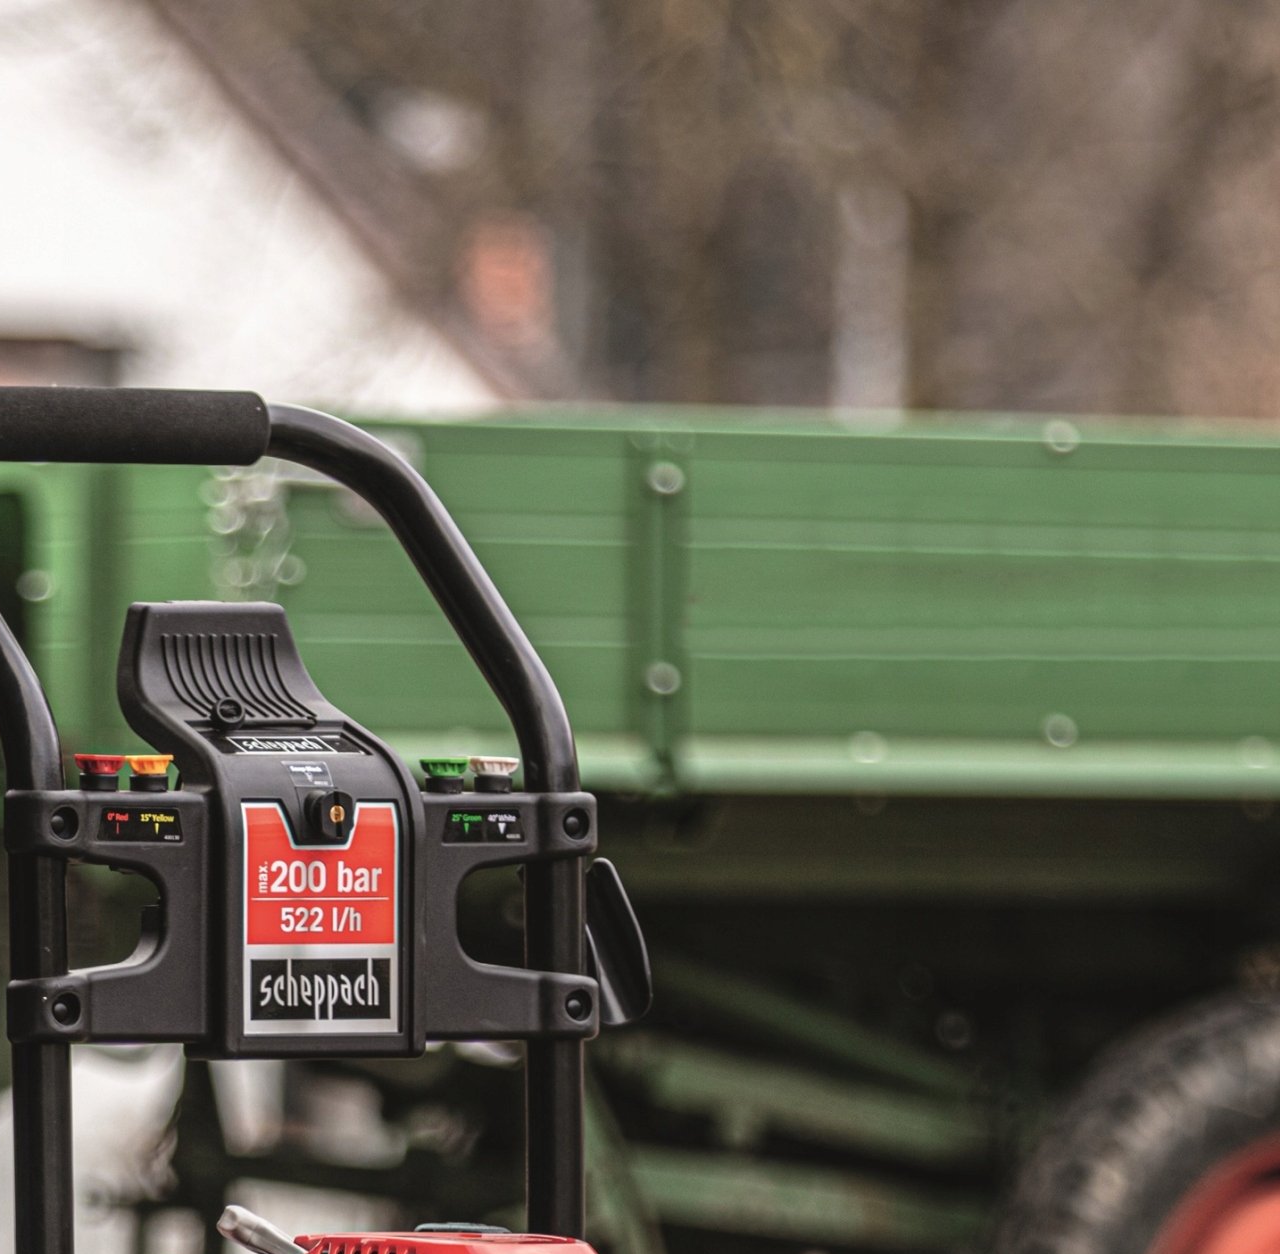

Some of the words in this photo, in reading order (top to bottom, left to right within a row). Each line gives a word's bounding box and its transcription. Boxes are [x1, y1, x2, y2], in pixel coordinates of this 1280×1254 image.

[242, 737, 323, 753] scheppach
[116, 813, 129, 821] Red
[152, 813, 175, 823] Yellow
[463, 814, 483, 822] Green
[498, 814, 517, 822] White
[258, 861, 269, 894] max.
[270, 860, 327, 893] 200
[337, 861, 382, 893] bar
[280, 907, 324, 932] 522
[332, 907, 362, 932] l/h
[260, 958, 379, 1020] scheppach
